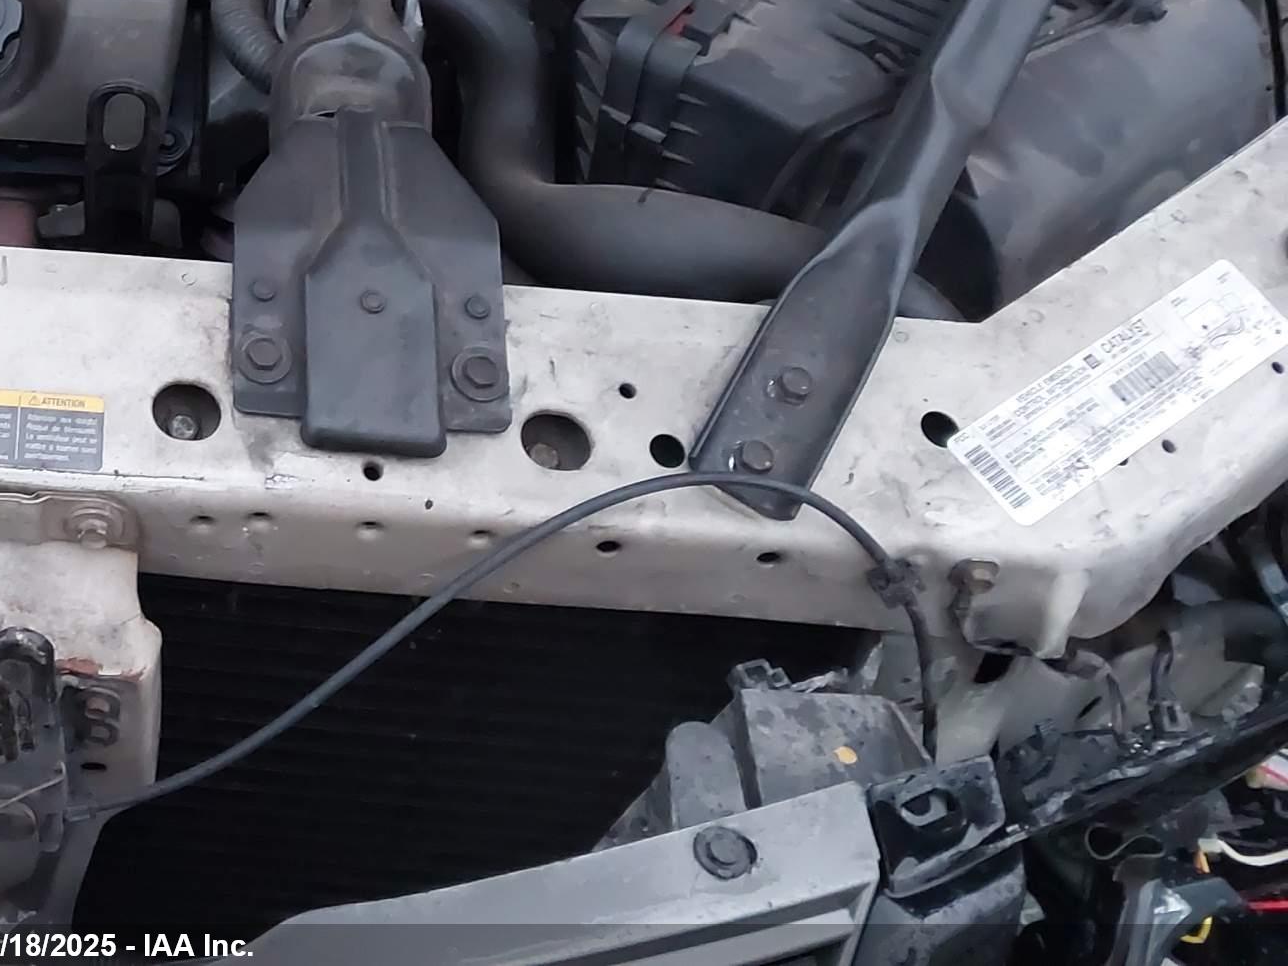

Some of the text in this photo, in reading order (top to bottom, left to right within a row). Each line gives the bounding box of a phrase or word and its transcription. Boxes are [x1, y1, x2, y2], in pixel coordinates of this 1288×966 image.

[1100, 317, 1147, 354] CATALYST
[1015, 362, 1073, 404] VEHICLE EMISSION
[40, 397, 85, 408] ATTENTION
[1013, 392, 1045, 417] CONTROL
